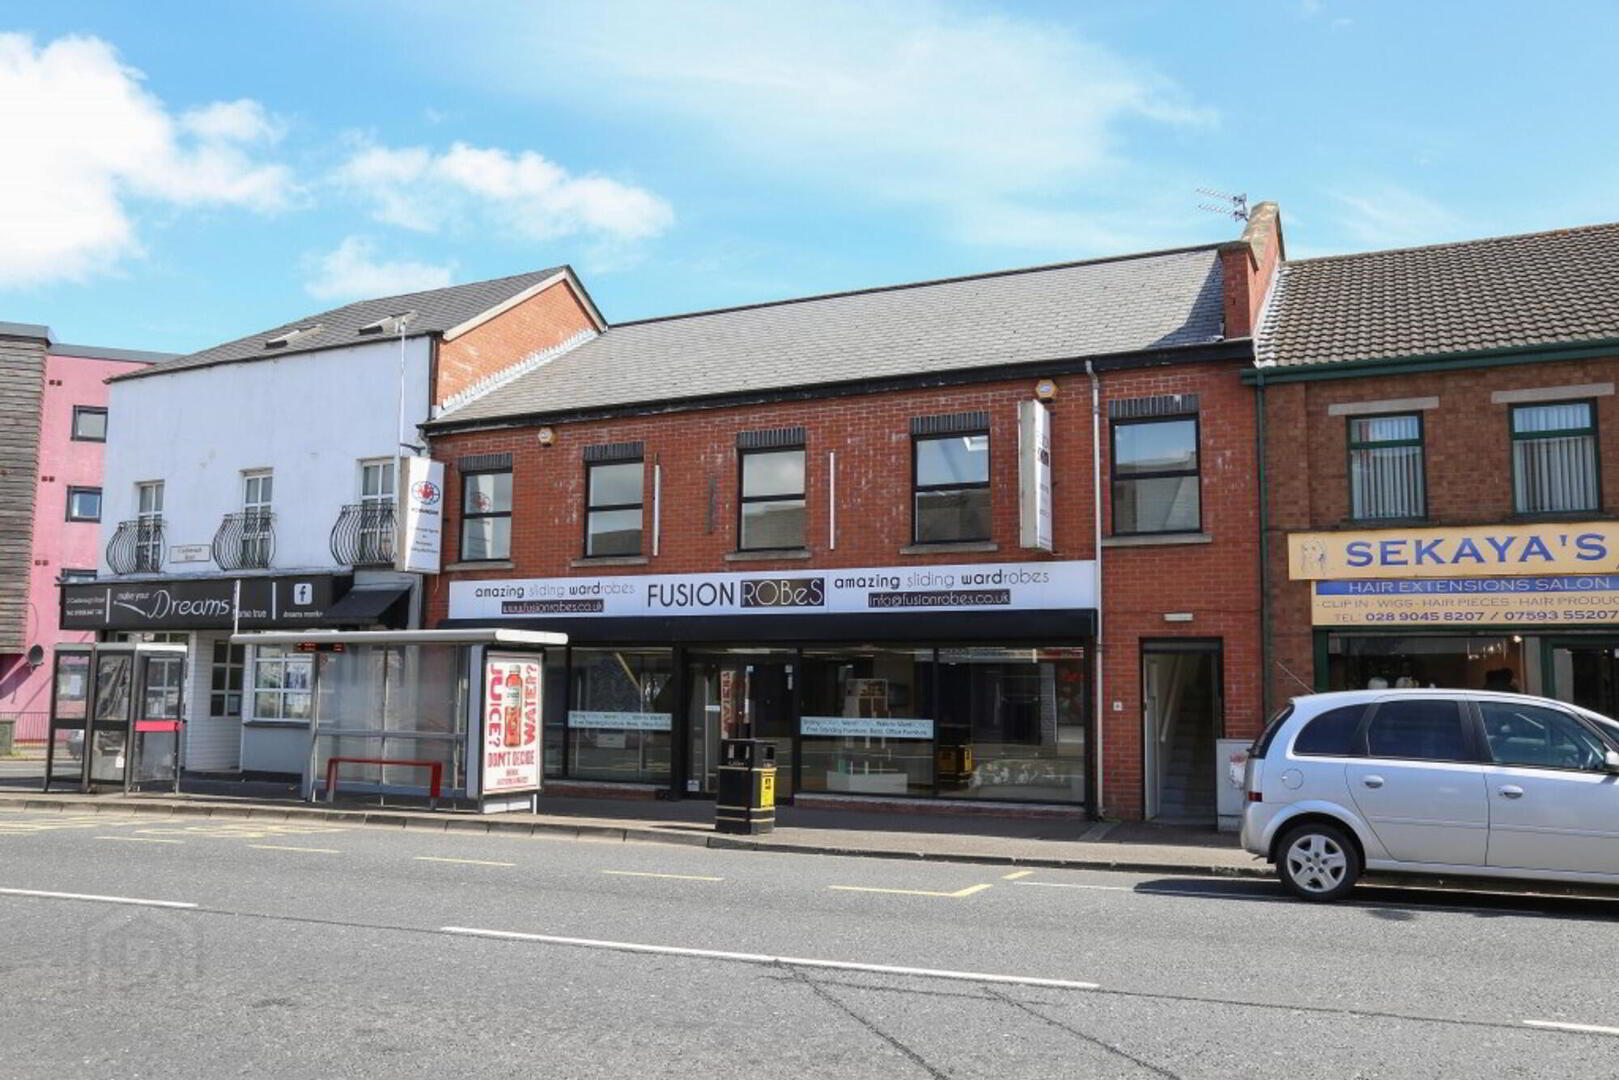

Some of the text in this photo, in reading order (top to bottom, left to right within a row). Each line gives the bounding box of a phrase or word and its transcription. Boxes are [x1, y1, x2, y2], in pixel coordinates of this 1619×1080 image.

[1345, 533, 1608, 567] SEKAYA'S
[475, 581, 635, 599] amazing sliding wardrobes
[834, 568, 1050, 590] amazing sliding wardrobes
[1349, 577, 1610, 594] HAIR EXTENSIONS SALON
[147, 589, 230, 619] Dreams
[648, 581, 734, 608] FUSION
[869, 589, 1010, 607] info@fusionrobes.co.uk
[1377, 599, 1413, 608] WIGS
[1423, 599, 1453, 608] HAIR
[1458, 597, 1509, 607] PIECES
[1519, 597, 1553, 606] HAIR
[1365, 611, 1395, 621] 028
[1400, 611, 1440, 621] 9045
[1444, 611, 1485, 621] 8207
[1504, 611, 1558, 620] 07593
[1563, 610, 1619, 620] 55207
[488, 664, 503, 748] JUICE?
[524, 664, 537, 746] WATER?
